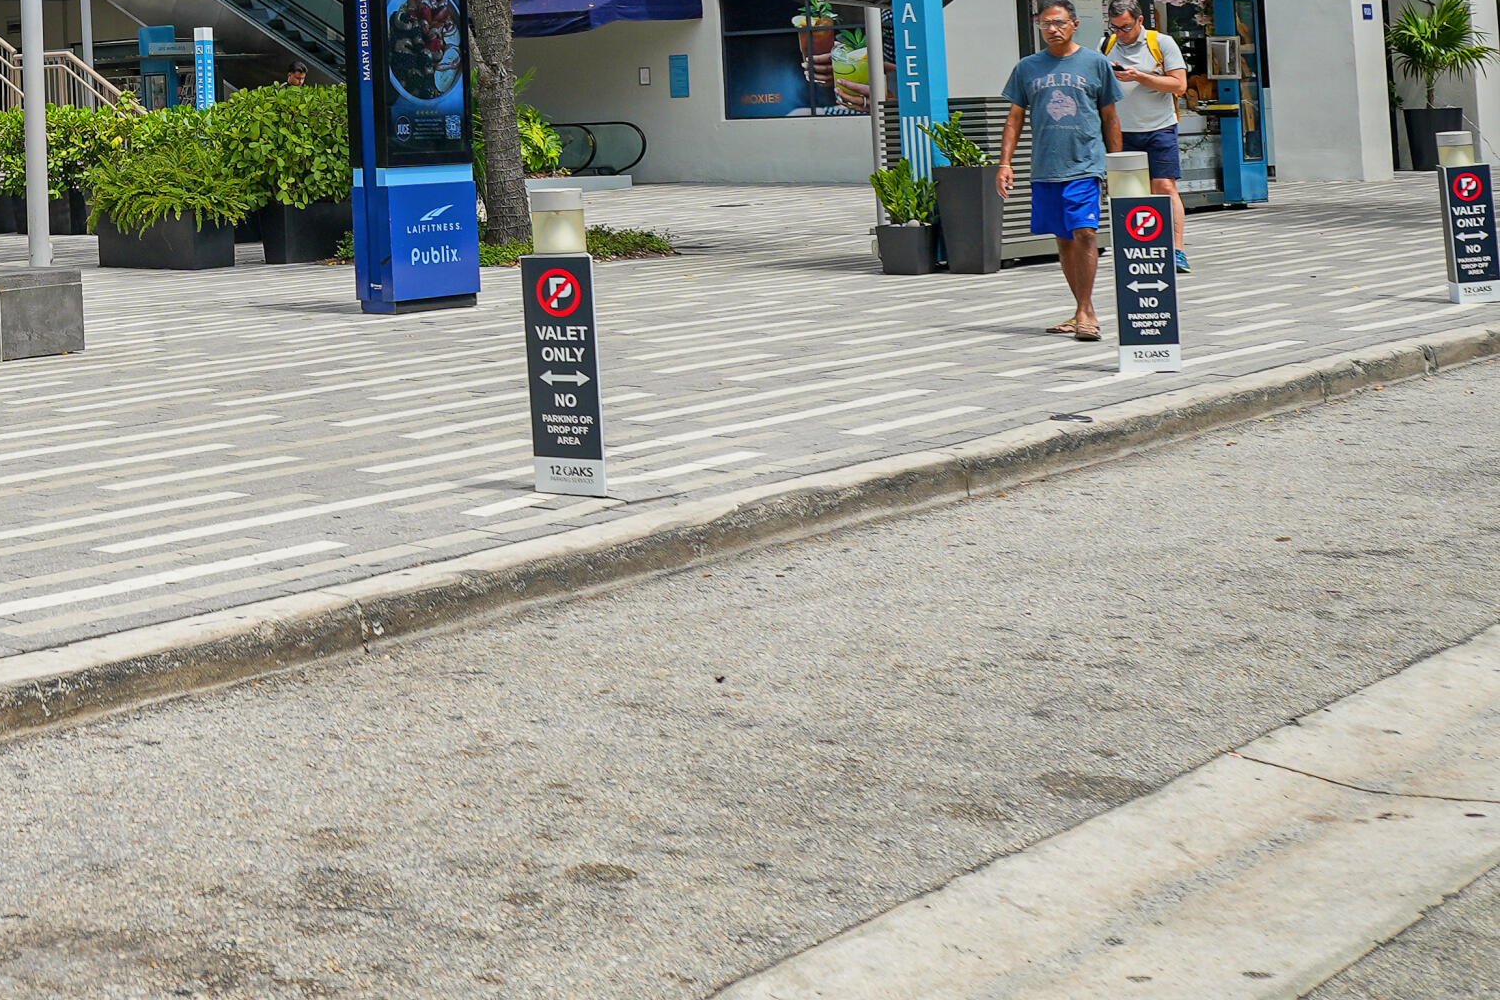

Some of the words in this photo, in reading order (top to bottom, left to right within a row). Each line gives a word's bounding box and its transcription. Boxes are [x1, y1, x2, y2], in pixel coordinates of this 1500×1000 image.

[361, 50, 371, 81] MARY
[1451, 204, 1487, 216] VALET
[1456, 216, 1486, 228] ONLY
[1123, 247, 1168, 260] VALET
[1465, 244, 1482, 254] NO
[1128, 262, 1165, 275] ONLY
[1139, 296, 1159, 308] NO
[1127, 312, 1159, 321] PARKING
[1159, 311, 1172, 320] OR
[1131, 320, 1152, 329] DROP
[1153, 319, 1168, 328] OFF
[534, 325, 589, 341] VALET
[1140, 328, 1161, 336] AREA
[541, 346, 586, 363] ONLY
[1133, 350, 1143, 359] 12
[1144, 349, 1171, 358] OAKS
[554, 393, 577, 408] NO
[541, 413, 579, 425] PARKING
[579, 415, 594, 425] OR
[547, 425, 571, 434] DROP
[571, 426, 589, 435] OFF
[557, 436, 581, 446] AREA
[550, 465, 562, 476] 12
[563, 465, 594, 478] OAKS
